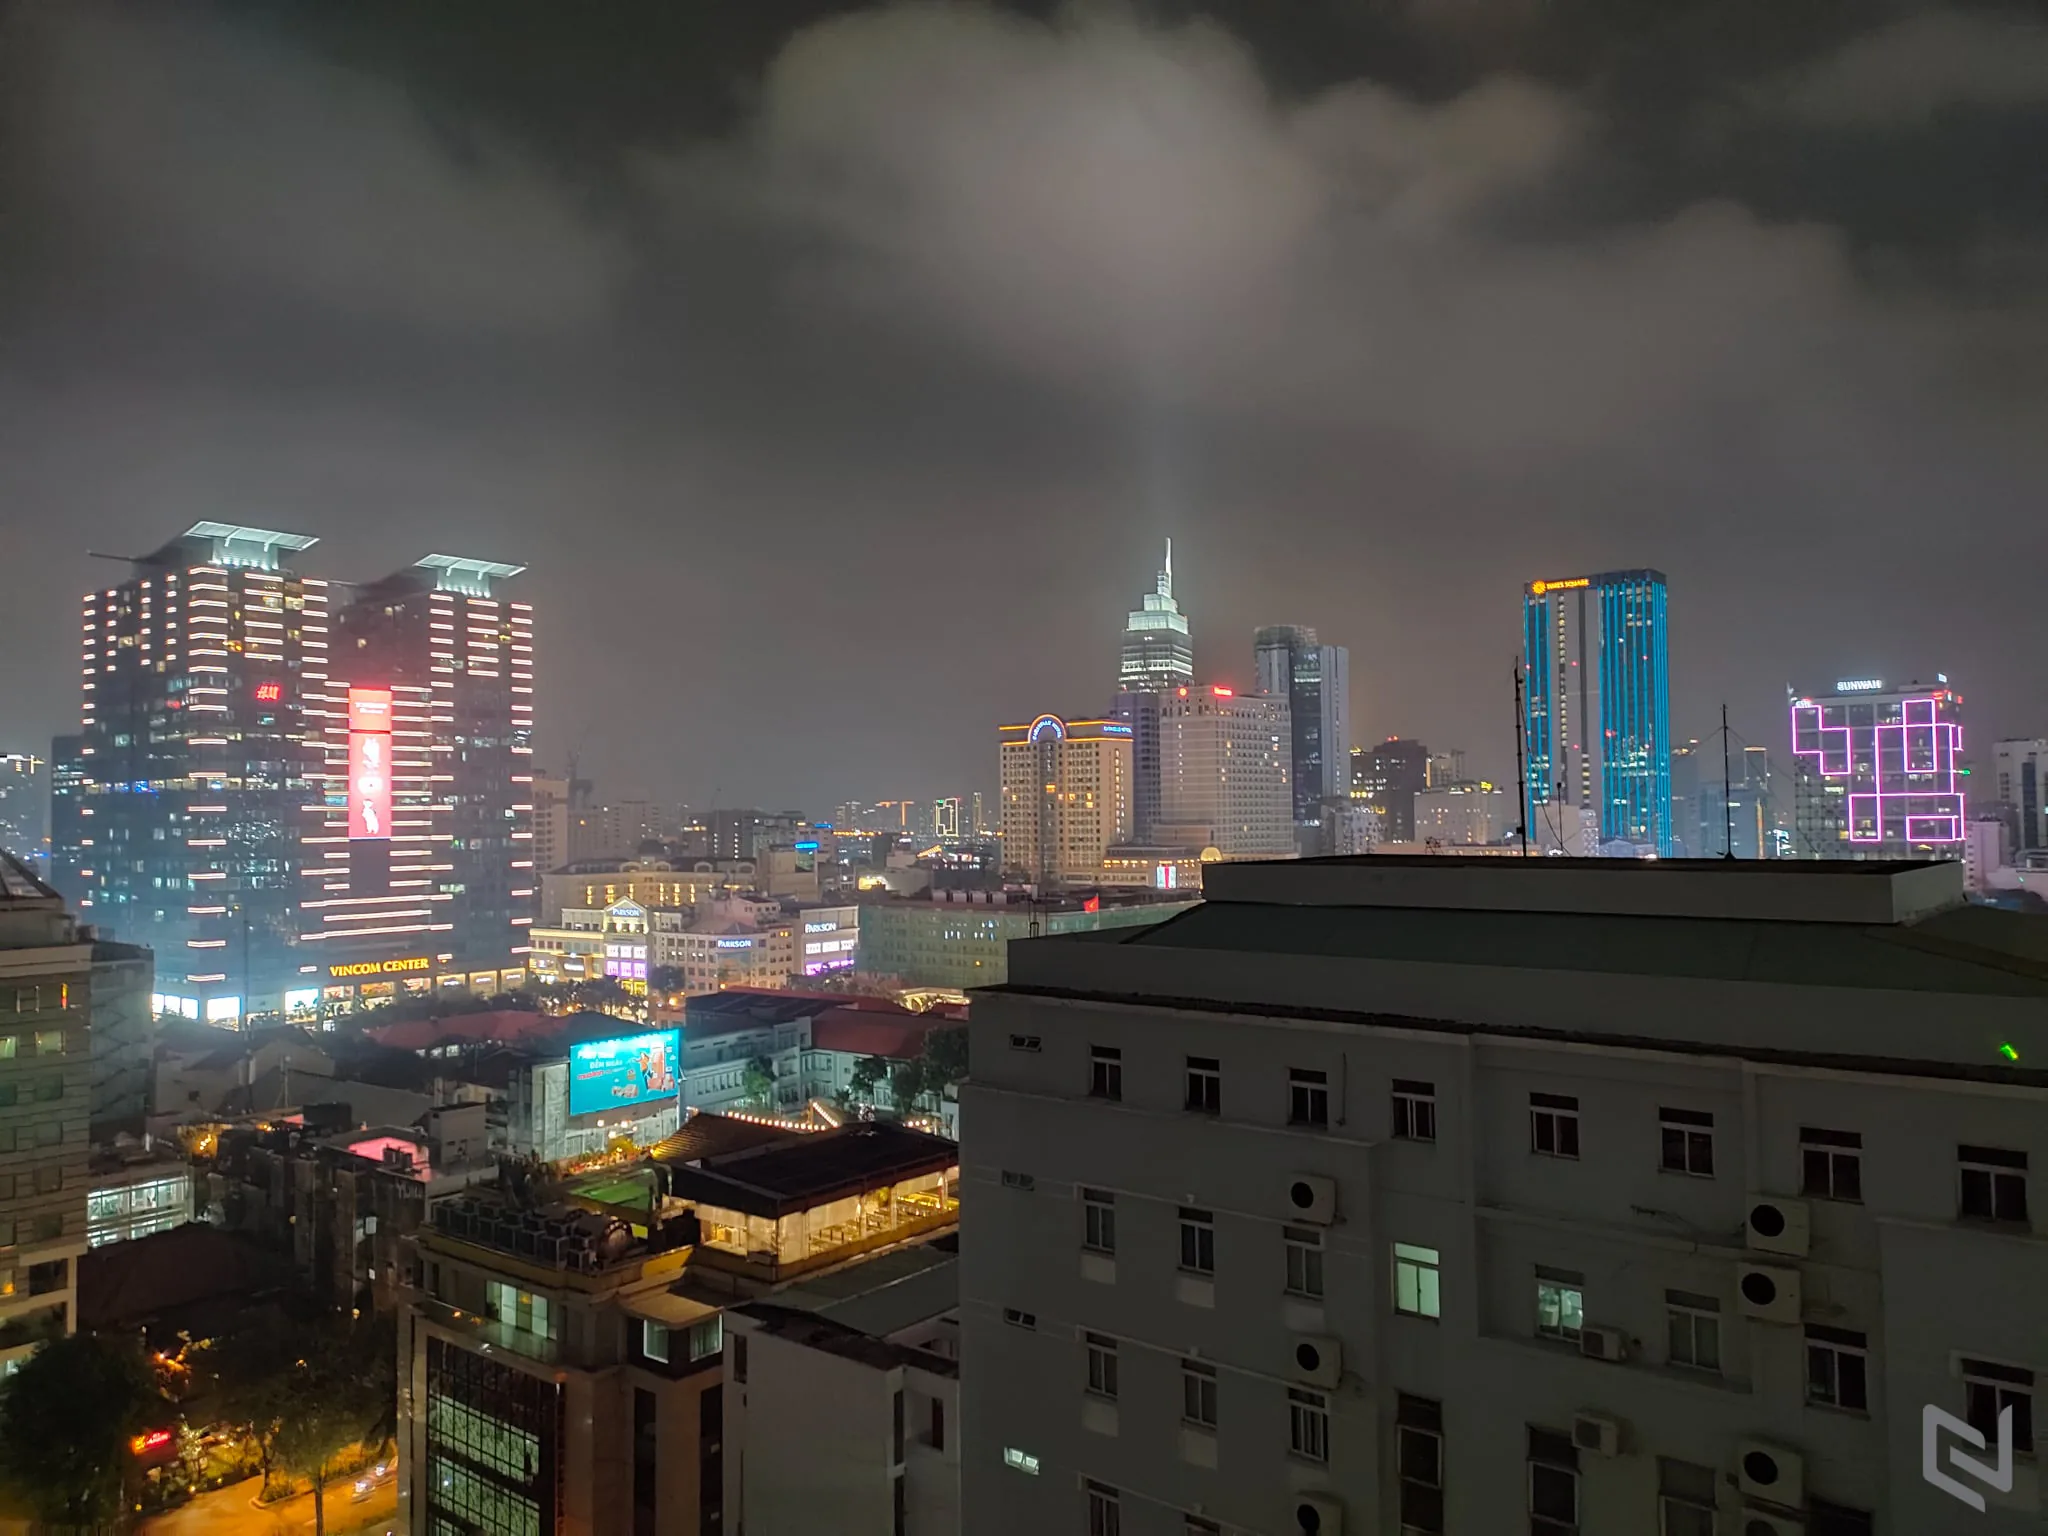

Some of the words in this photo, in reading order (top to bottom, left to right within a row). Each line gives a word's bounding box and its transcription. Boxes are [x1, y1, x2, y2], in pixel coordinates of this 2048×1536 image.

[1837, 680, 1882, 691] SUNWAH
[805, 922, 837, 934] PARKSON
[717, 939, 752, 948] PARKSON
[329, 962, 381, 977] VINCOM
[382, 958, 429, 972] CENTER
